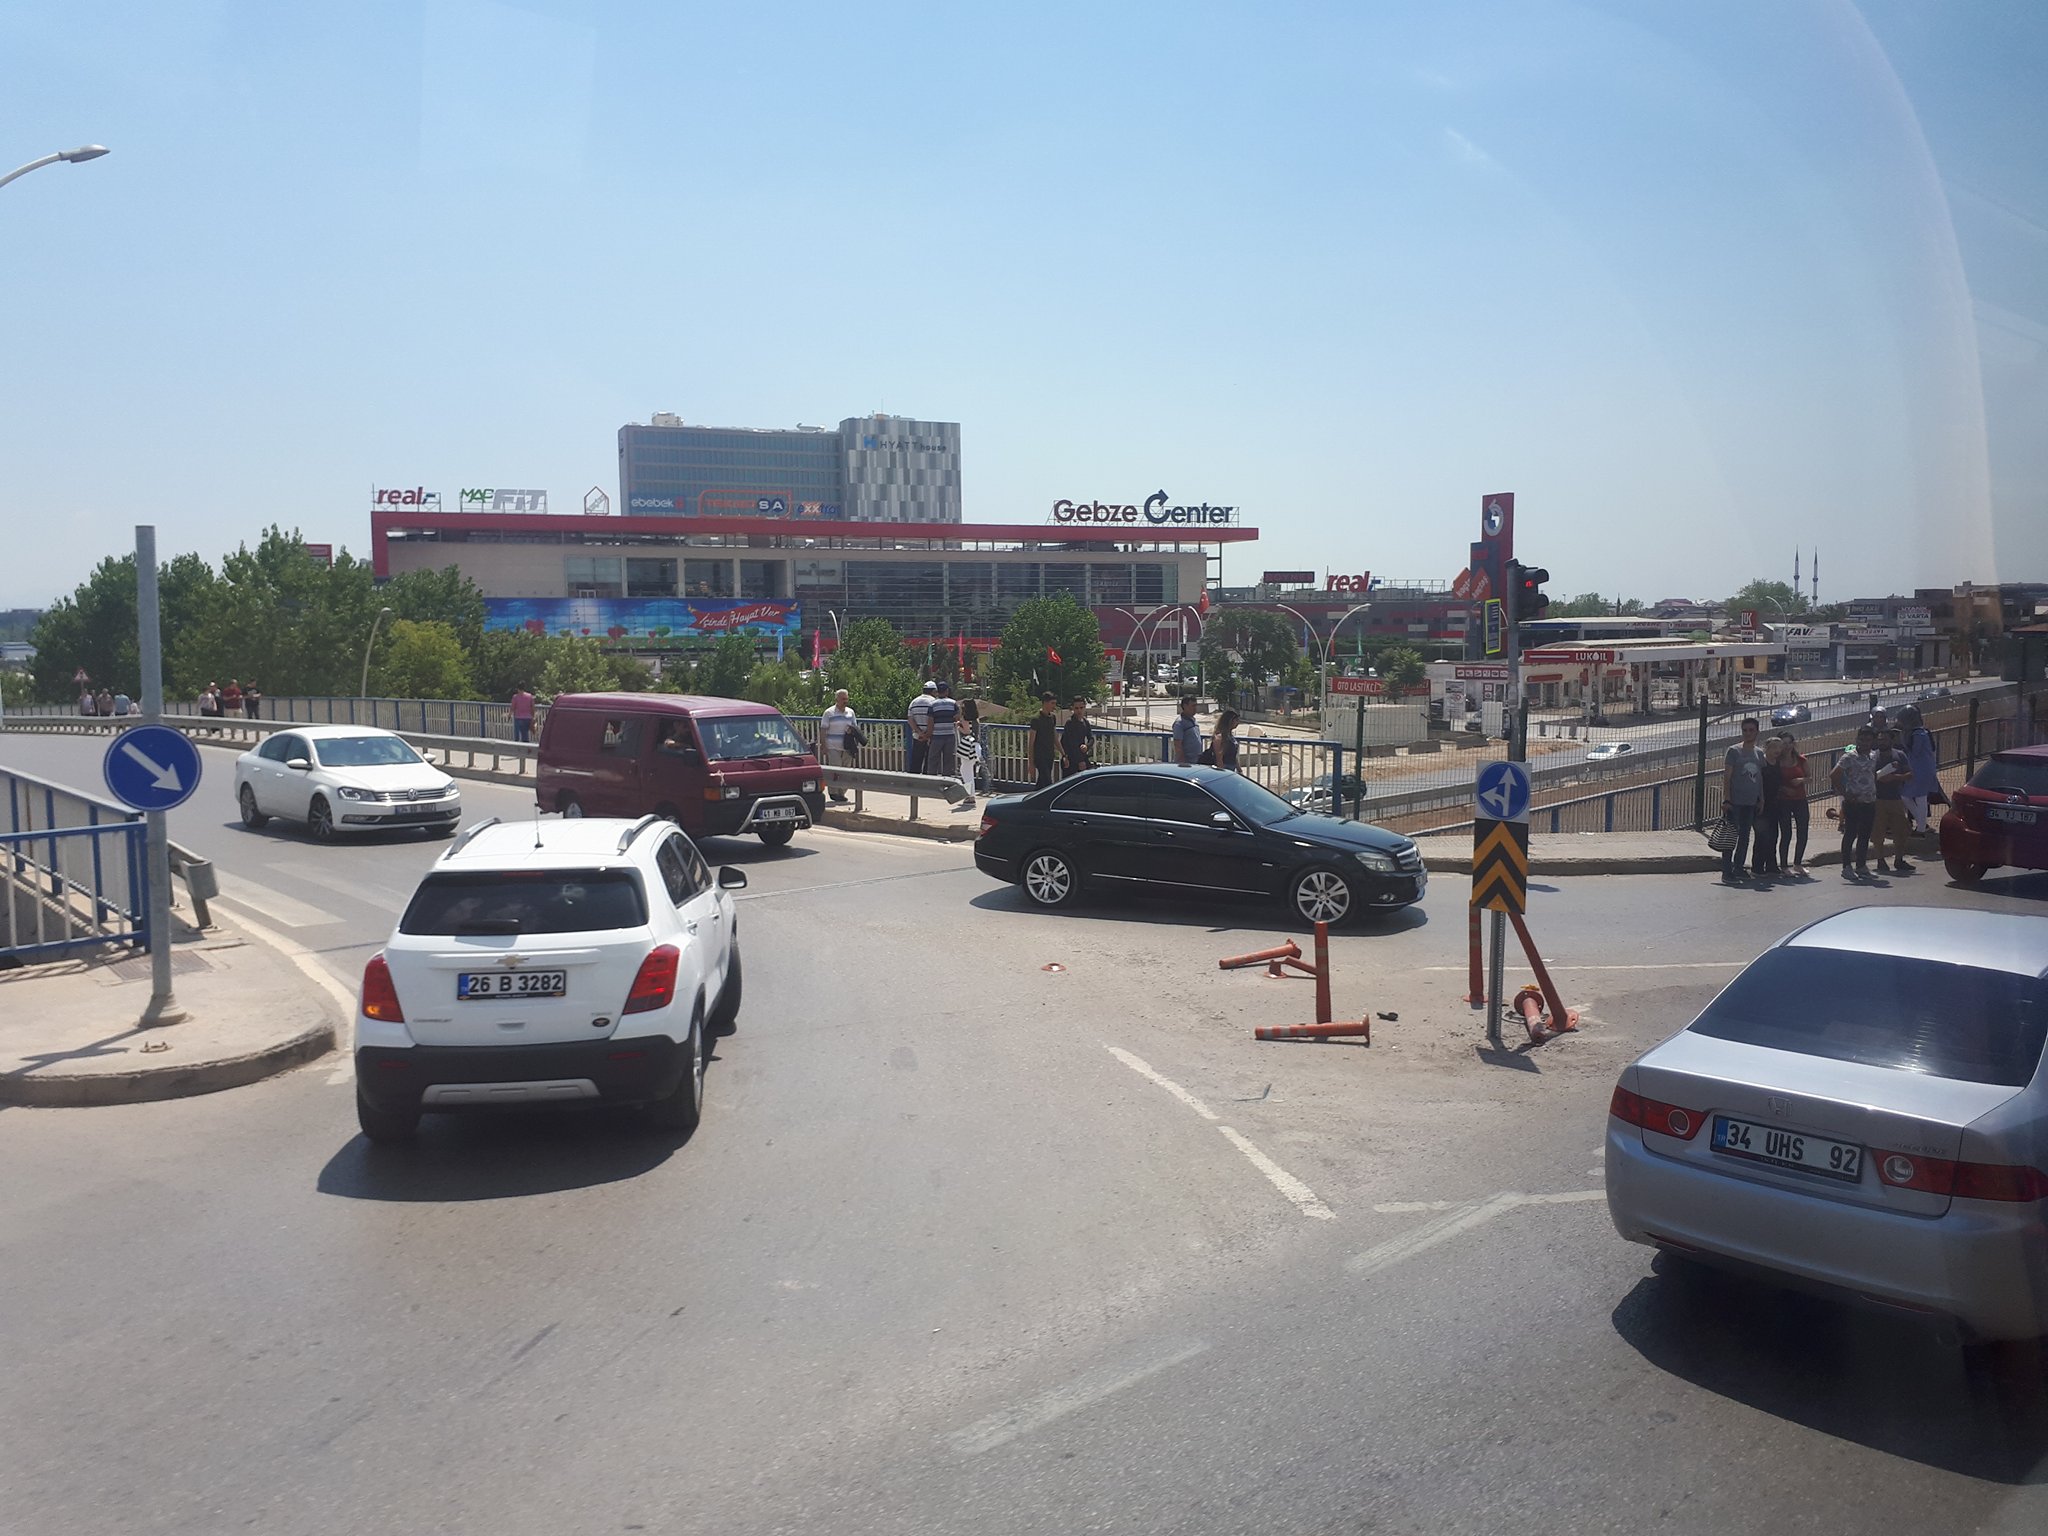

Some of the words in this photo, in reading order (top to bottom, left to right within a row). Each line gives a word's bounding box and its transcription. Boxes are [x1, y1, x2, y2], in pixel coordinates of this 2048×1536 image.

[880, 440, 919, 449] HYATT
[631, 499, 674, 508] ebebek
[1053, 499, 1138, 523] Gebze
[1144, 489, 1233, 524] Center
[1576, 652, 1608, 661] LUKOIL
[1337, 681, 1349, 691] OTO
[469, 976, 490, 993] 26
[500, 976, 512, 991] B
[518, 974, 562, 991] 3282
[1728, 1123, 1751, 1150] 34
[1765, 1131, 1804, 1161] UHS
[1829, 1145, 1858, 1173] 92
